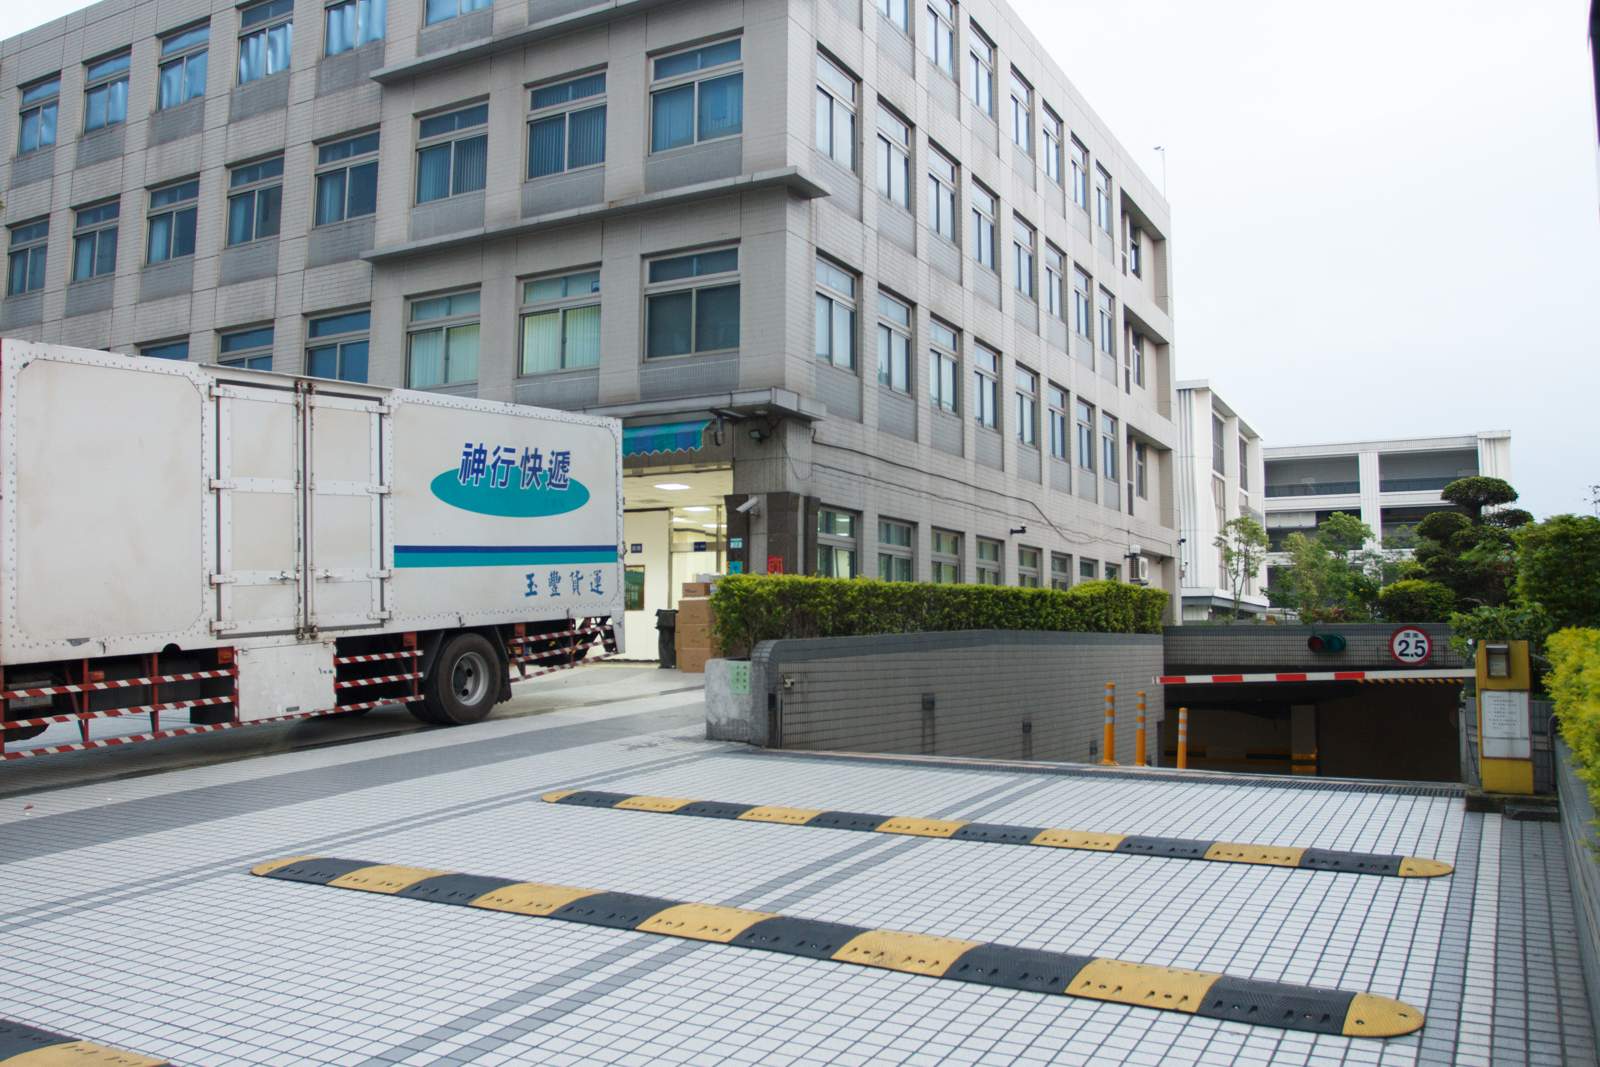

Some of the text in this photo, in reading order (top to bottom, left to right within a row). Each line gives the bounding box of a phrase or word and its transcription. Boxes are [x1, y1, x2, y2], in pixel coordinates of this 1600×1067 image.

[459, 442, 571, 490] 神行快遞
[1398, 640, 1426, 657] 2.5
